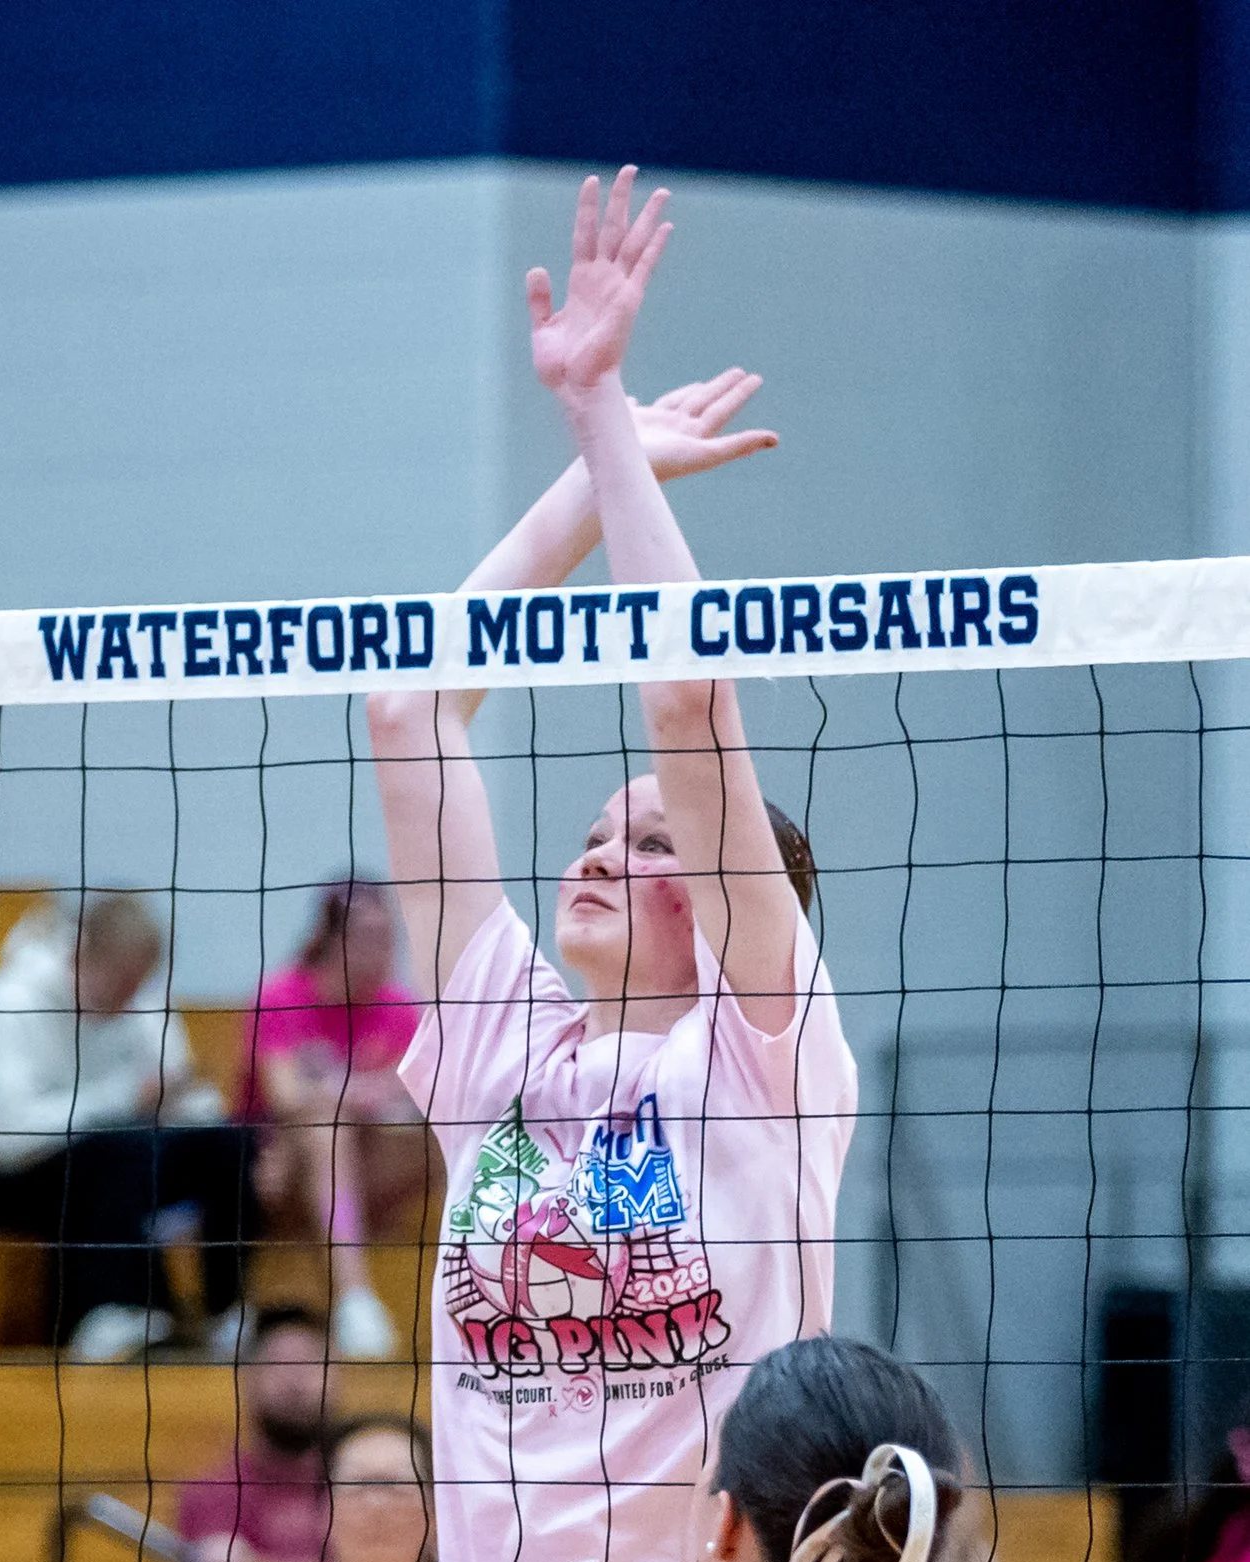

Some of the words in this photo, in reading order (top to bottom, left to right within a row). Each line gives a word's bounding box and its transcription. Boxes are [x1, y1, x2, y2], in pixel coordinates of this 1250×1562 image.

[37, 600, 434, 682] WATERFORD
[466, 591, 659, 667] MOTT
[689, 574, 1040, 657] CORSAIRS
[633, 1260, 709, 1303] 2026
[546, 1288, 731, 1374] PINK
[650, 1381, 674, 1396] FOR
